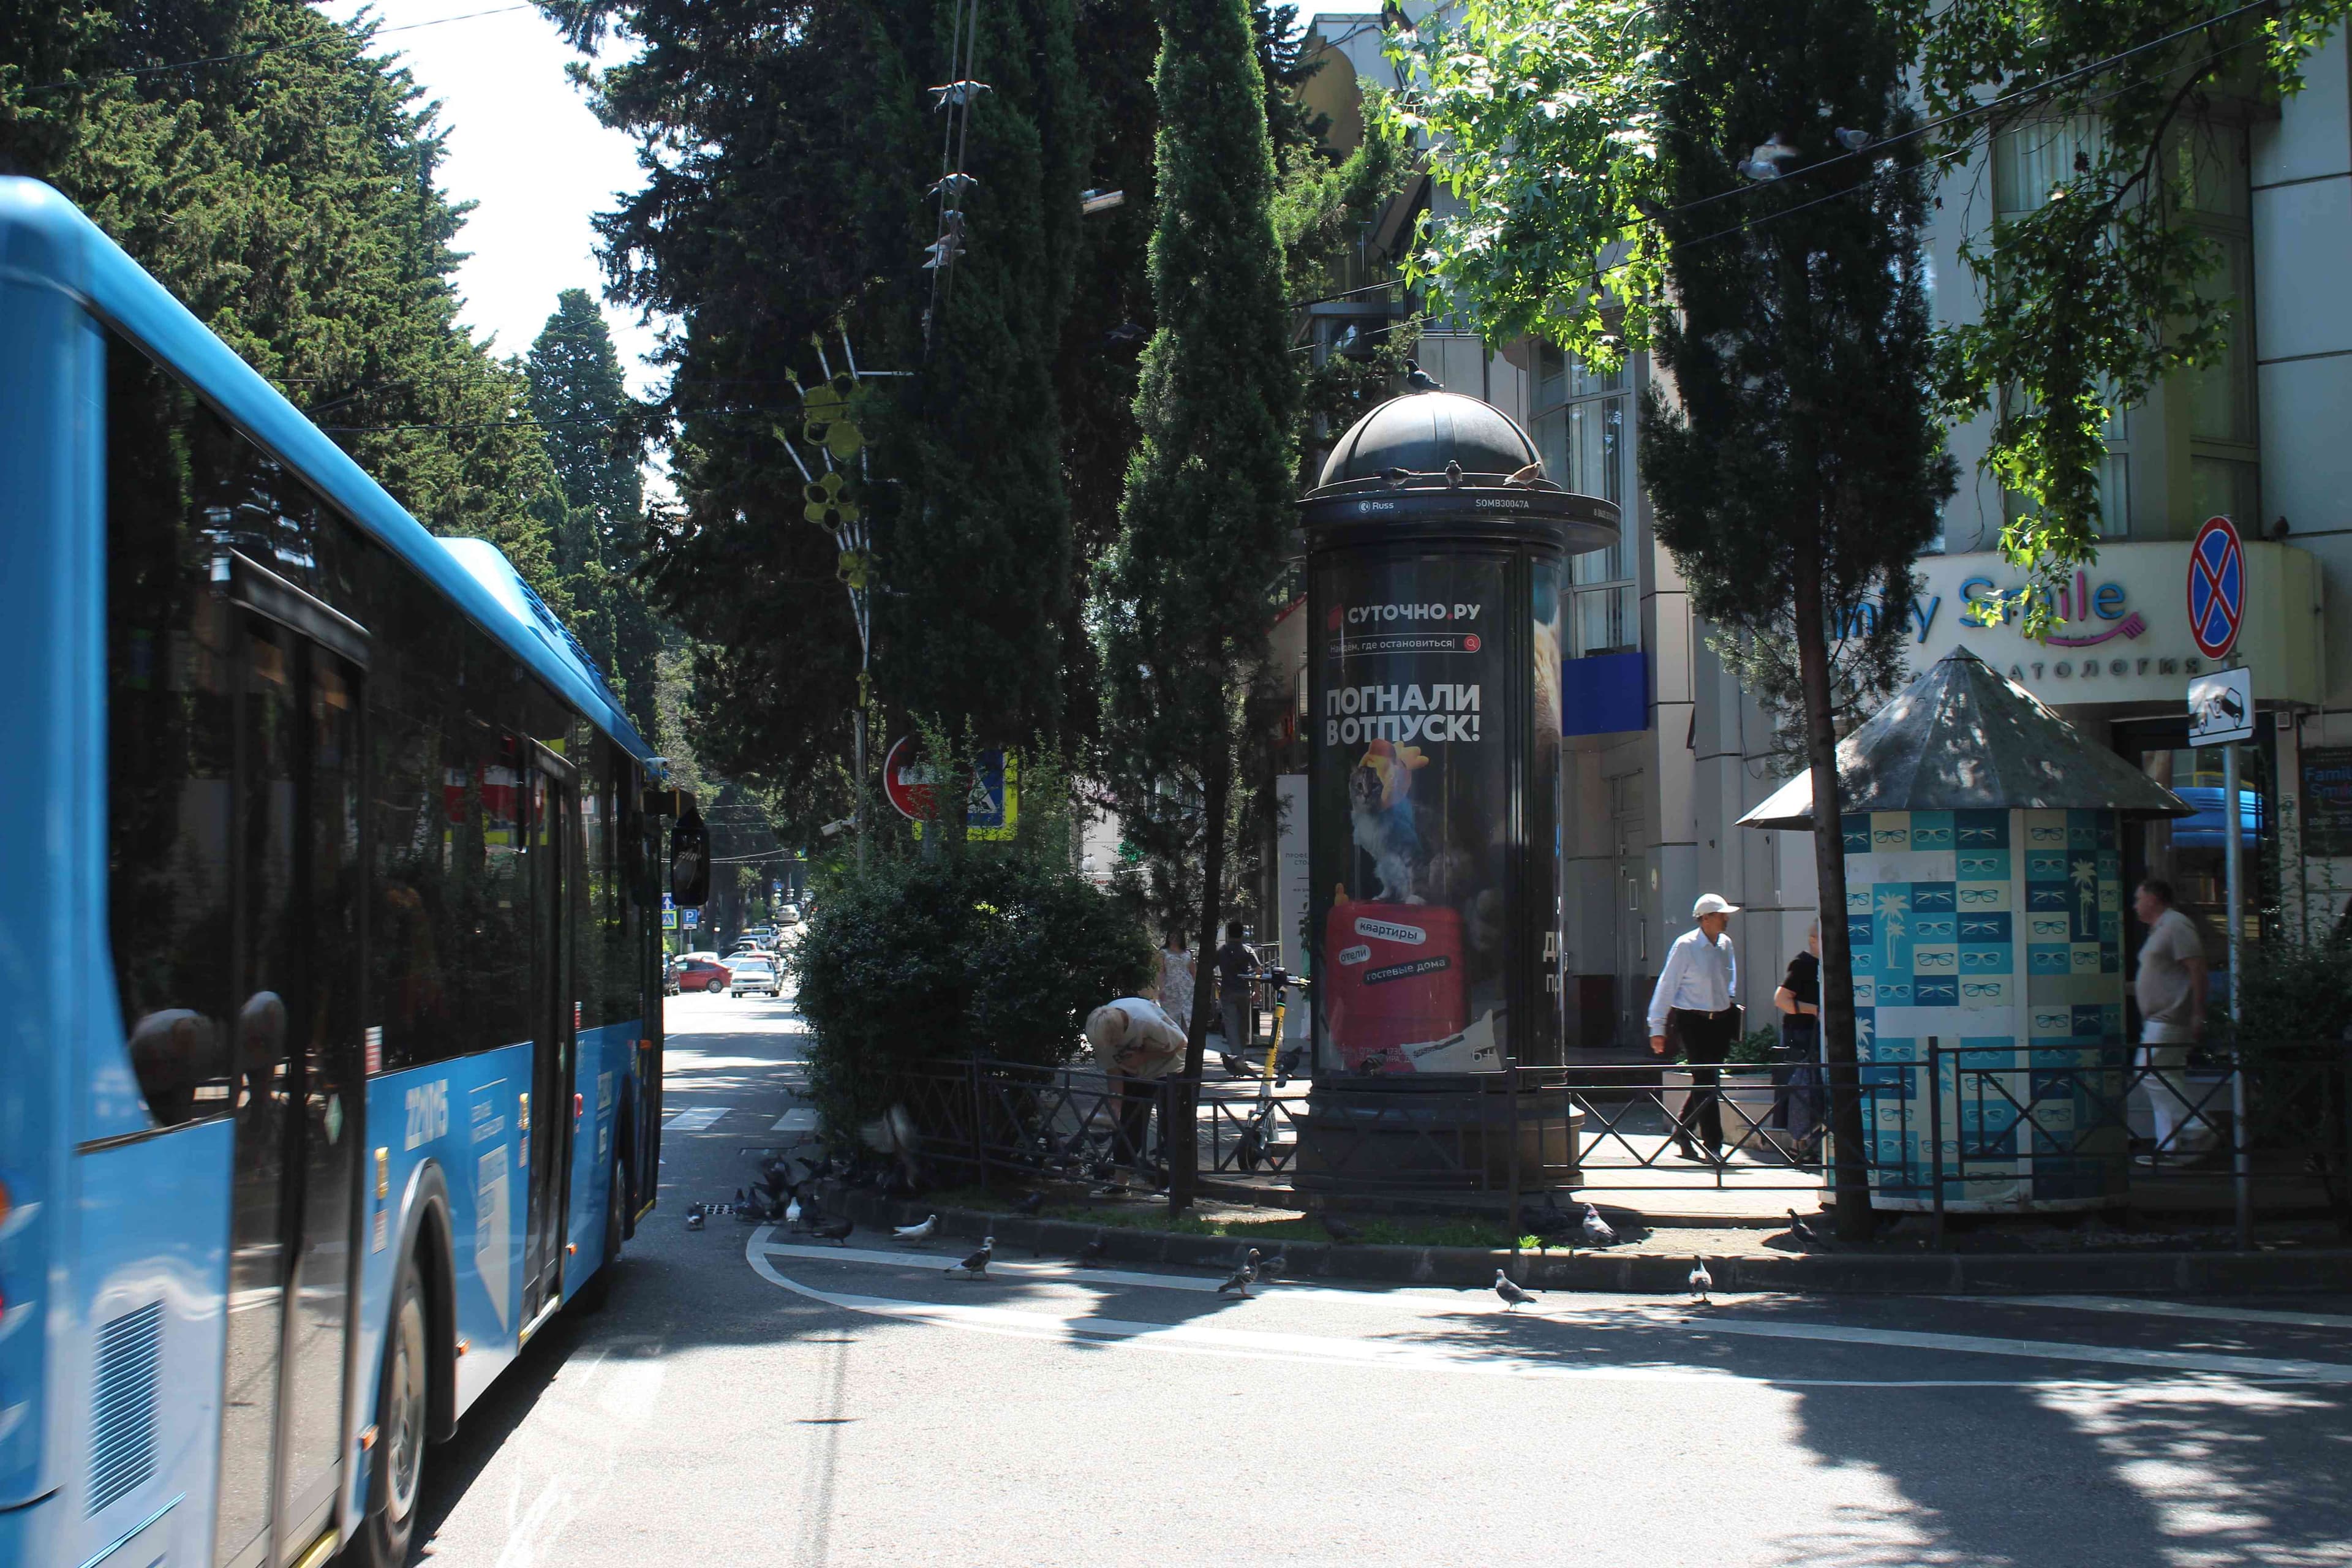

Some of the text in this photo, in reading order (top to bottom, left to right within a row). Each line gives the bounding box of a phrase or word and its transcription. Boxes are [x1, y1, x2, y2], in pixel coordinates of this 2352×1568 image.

[1348, 603, 1481, 624] СУТОЧНО.РУ
[1379, 639, 1452, 649] остановиться
[1327, 684, 1480, 716] ПОГНАЛИ
[685, 911, 694, 922] P
[1360, 922, 1418, 940] квартиры
[1340, 949, 1367, 962] отели
[1366, 959, 1446, 981] гостевые дома
[1472, 1046, 1494, 1063] 6+
